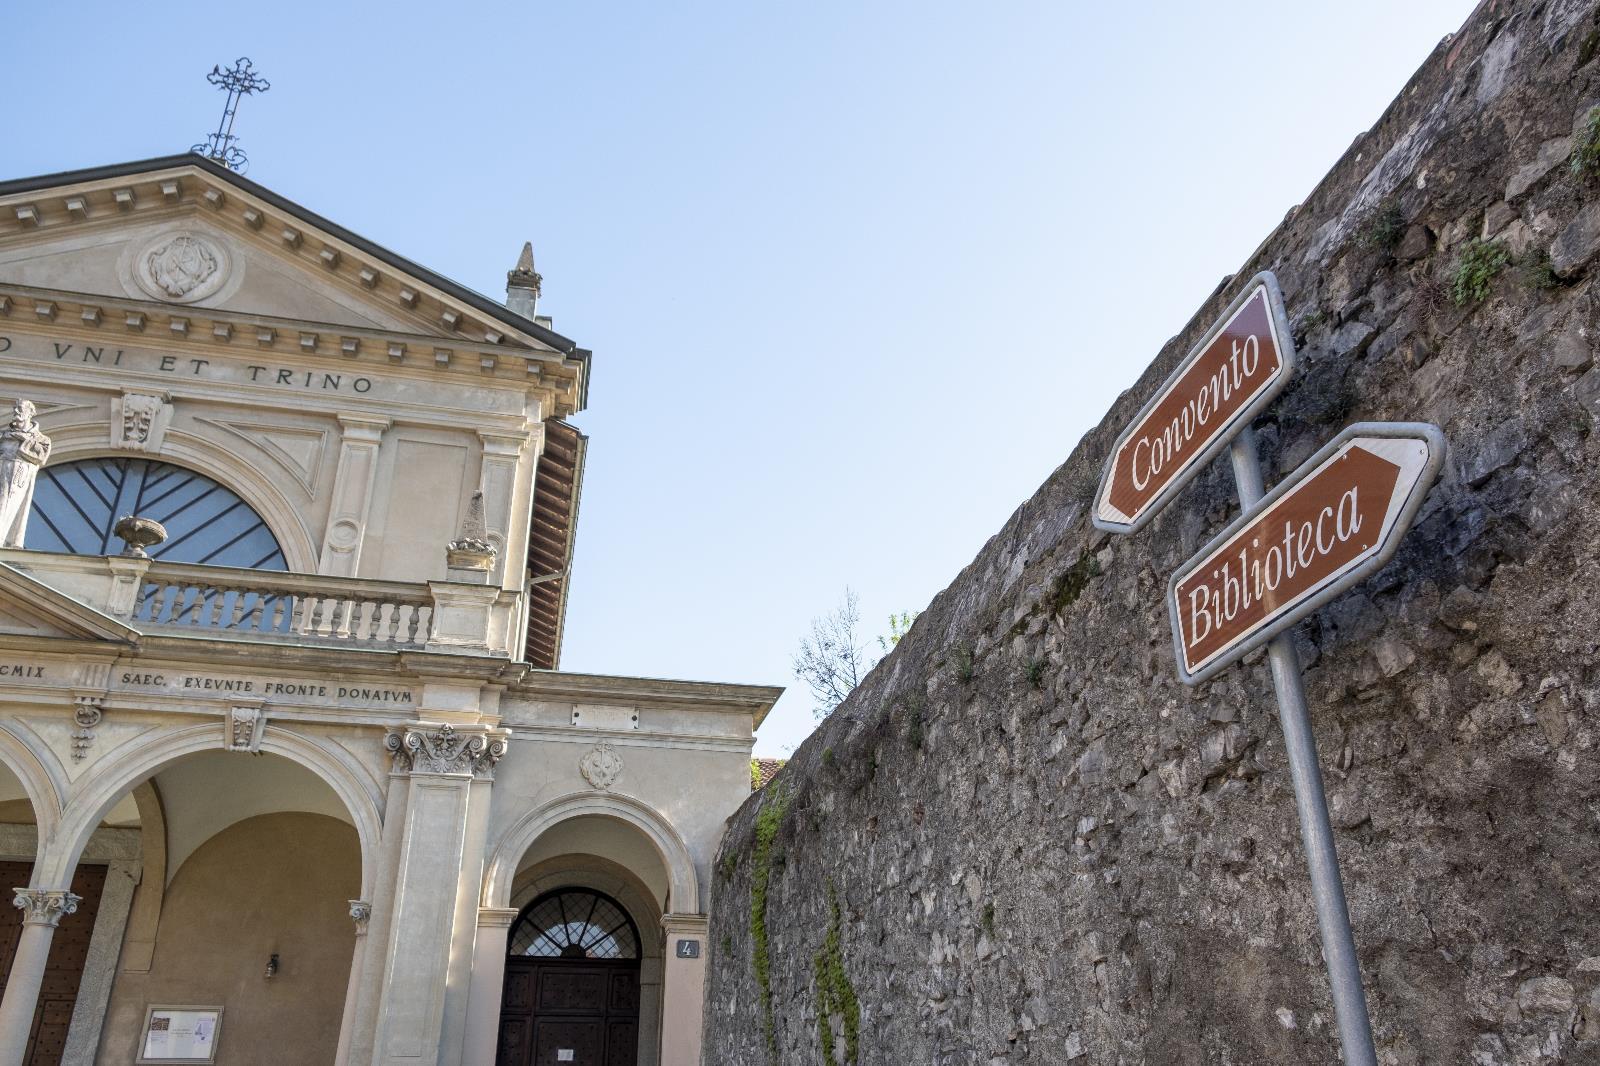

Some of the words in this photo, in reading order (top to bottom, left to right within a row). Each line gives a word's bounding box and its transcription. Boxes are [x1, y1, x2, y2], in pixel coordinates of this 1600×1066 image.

[53, 343, 124, 365] VNI
[159, 356, 209, 375] ET
[247, 365, 372, 393] TRINO
[1131, 334, 1259, 491] Convento
[1188, 485, 1363, 649] Biblioteca
[121, 673, 167, 687] SAEC.
[184, 677, 253, 692] EXEVNTE
[265, 683, 327, 697] FRONTE
[338, 687, 412, 702] DONATVM
[682, 941, 692, 956] 4
